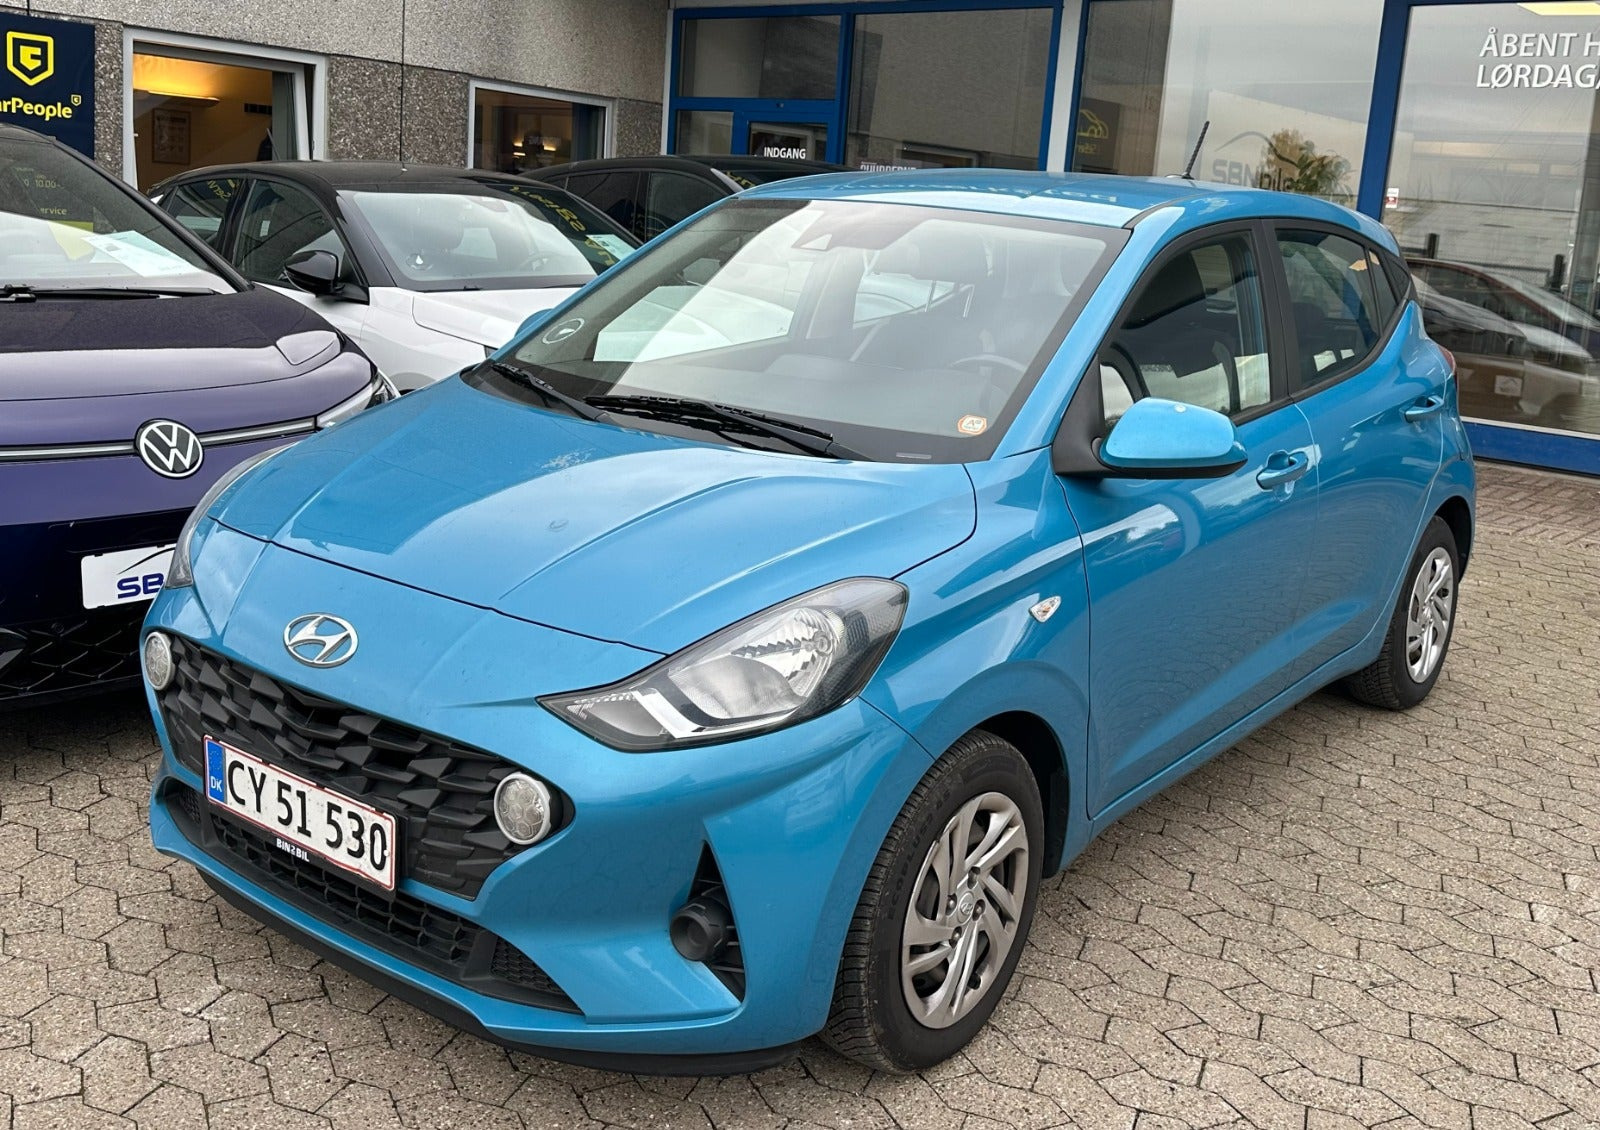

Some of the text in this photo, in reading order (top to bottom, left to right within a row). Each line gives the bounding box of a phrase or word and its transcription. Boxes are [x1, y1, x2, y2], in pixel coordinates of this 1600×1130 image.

[1479, 26, 1578, 57] ÅBENT
[1476, 63, 1600, 89] LØRDAG
[0, 97, 73, 121] rPeople
[763, 146, 806, 160] INDGANG
[210, 775, 223, 793] DK
[227, 759, 387, 872] CY 51 530
